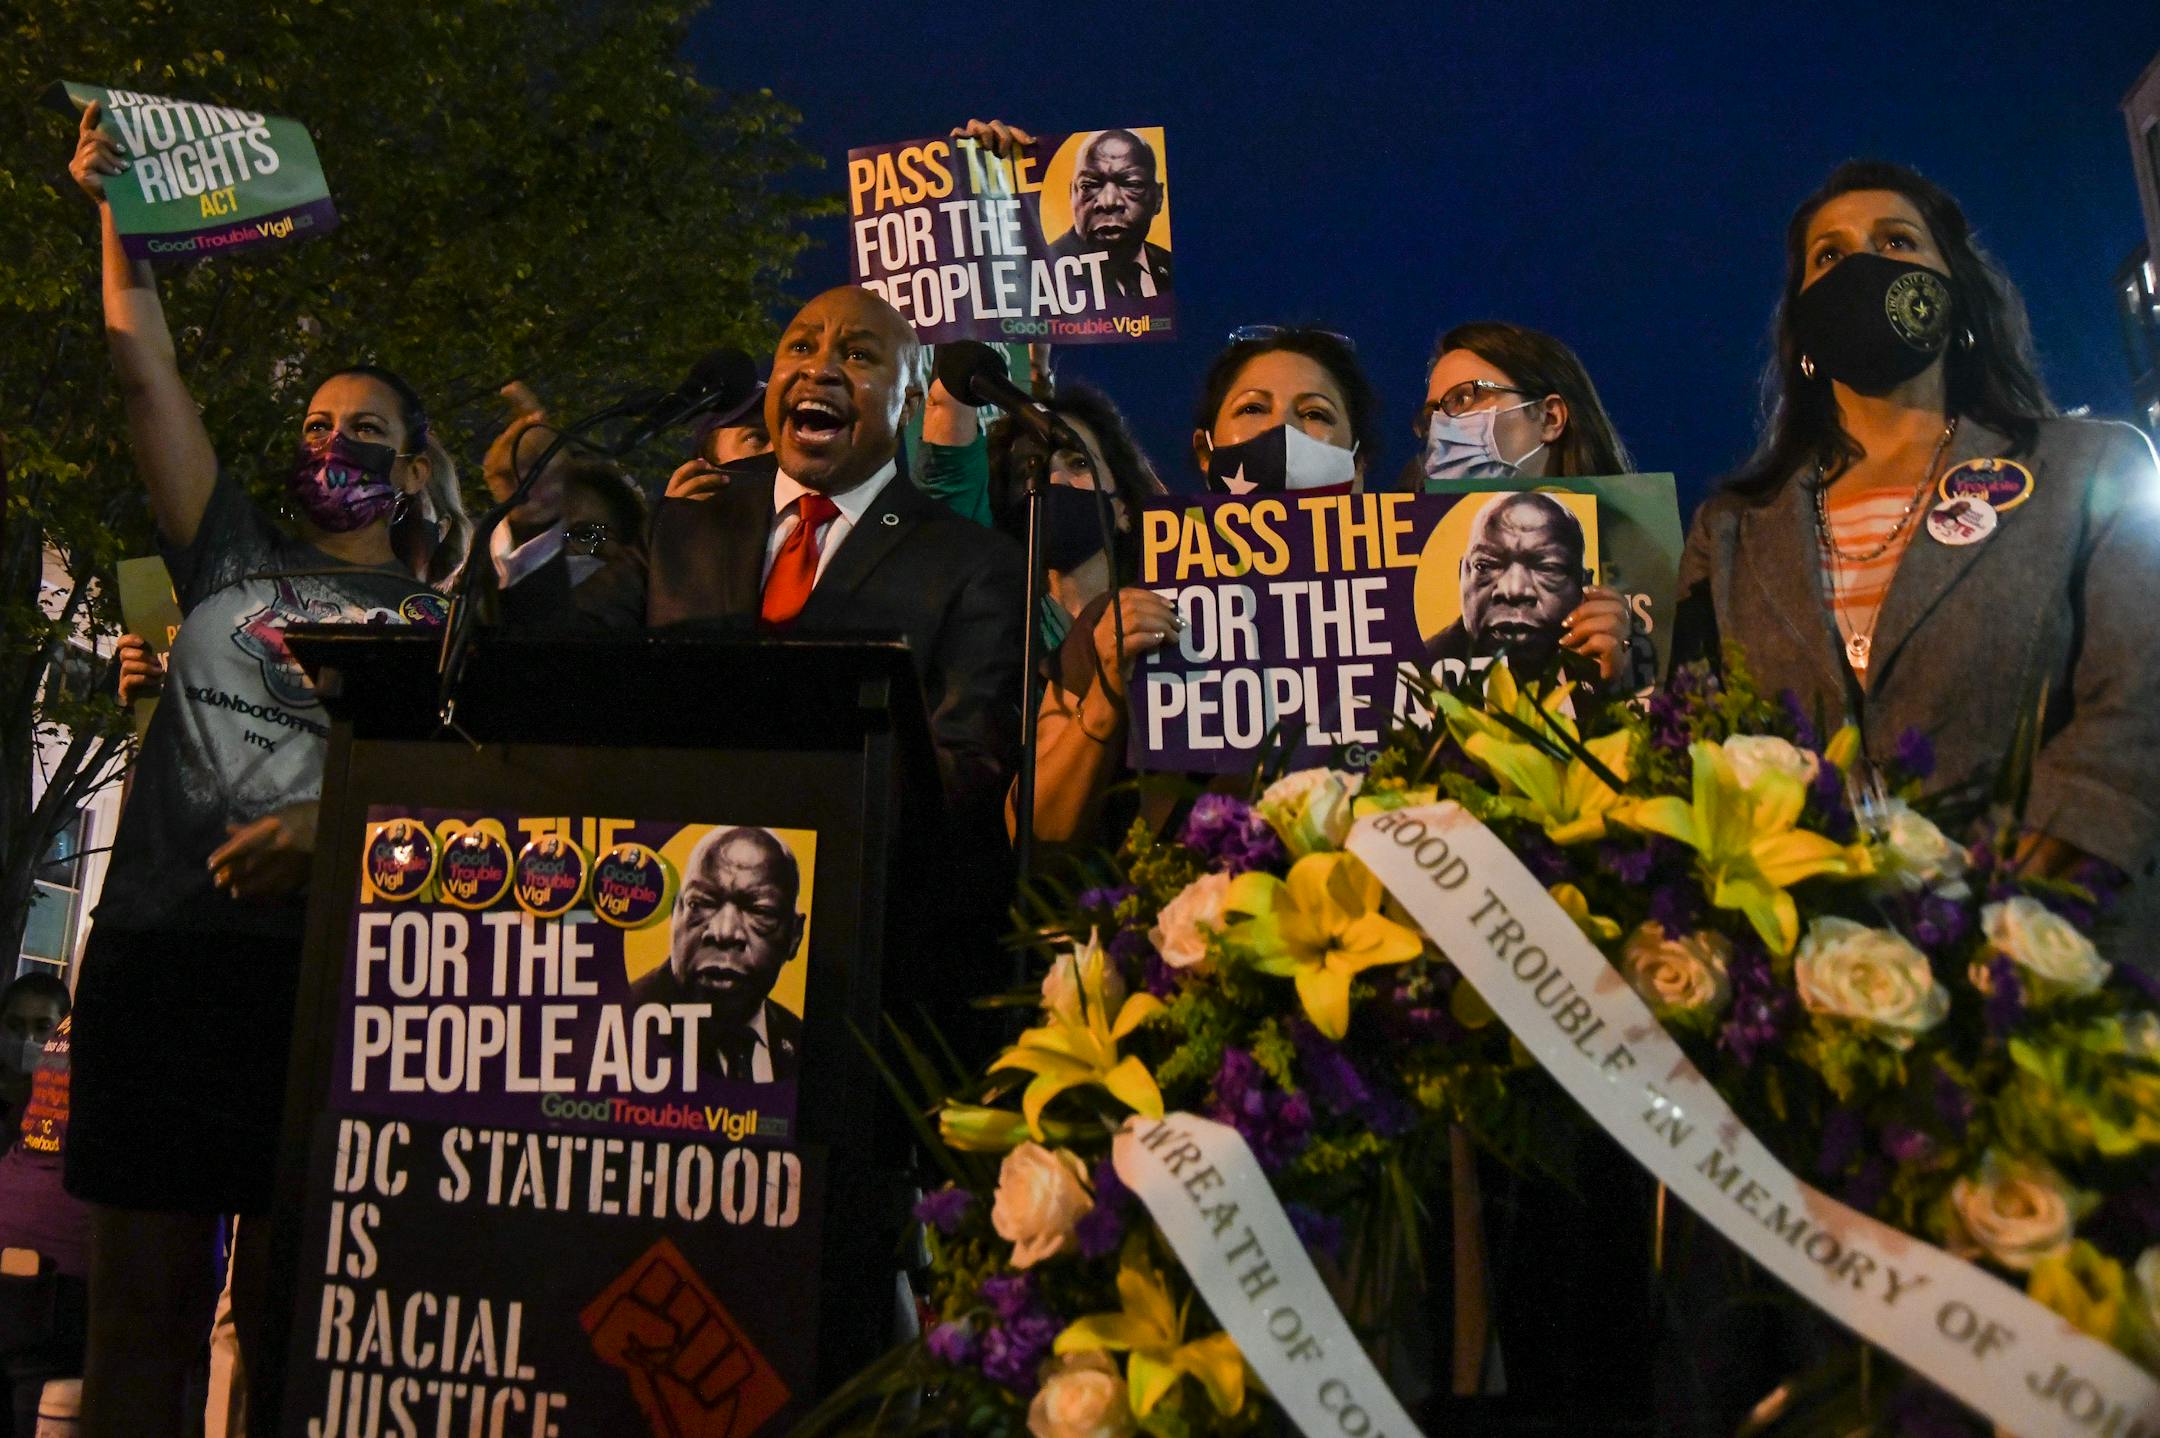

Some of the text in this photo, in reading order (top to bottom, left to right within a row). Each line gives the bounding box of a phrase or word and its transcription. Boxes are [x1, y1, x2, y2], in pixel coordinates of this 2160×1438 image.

[134, 126, 280, 204] RIGHTS
[848, 138, 1042, 216] PASS THE
[200, 187, 239, 219] ACT
[855, 199, 1028, 277] FOR THE
[1030, 251, 1110, 318] ACT
[1142, 493, 1420, 583] PASS THE
[1268, 577, 1394, 660] THE
[244, 729, 277, 753] HTX
[1147, 662, 1380, 751] PEOPLE
[374, 871, 404, 891] Vigil
[448, 879, 479, 899] Vigil
[451, 850, 490, 867] Good
[451, 865, 502, 882] Trouble
[525, 872, 576, 890] Trouble
[526, 856, 566, 874] Good
[600, 880, 657, 903] Trouble
[602, 864, 647, 884] Good
[522, 885, 552, 905] Vigil
[598, 891, 631, 915] Vigil
[355, 911, 600, 998] FOR THE
[351, 1003, 712, 1094] PEOPLE ACT
[1469, 888, 1638, 1077] TROUBLE
[1638, 1081, 1695, 1150] IN
[1694, 1148, 1932, 1306] MEMORY
[1935, 1300, 2018, 1361] OF
[332, 1119, 802, 1228] DC STATEHOOD
[325, 1200, 381, 1279] IS
[1140, 1120, 1387, 1438] WREATH OF CO
[315, 1284, 536, 1381] RACIAL
[307, 1368, 567, 1438] JUSTICE
